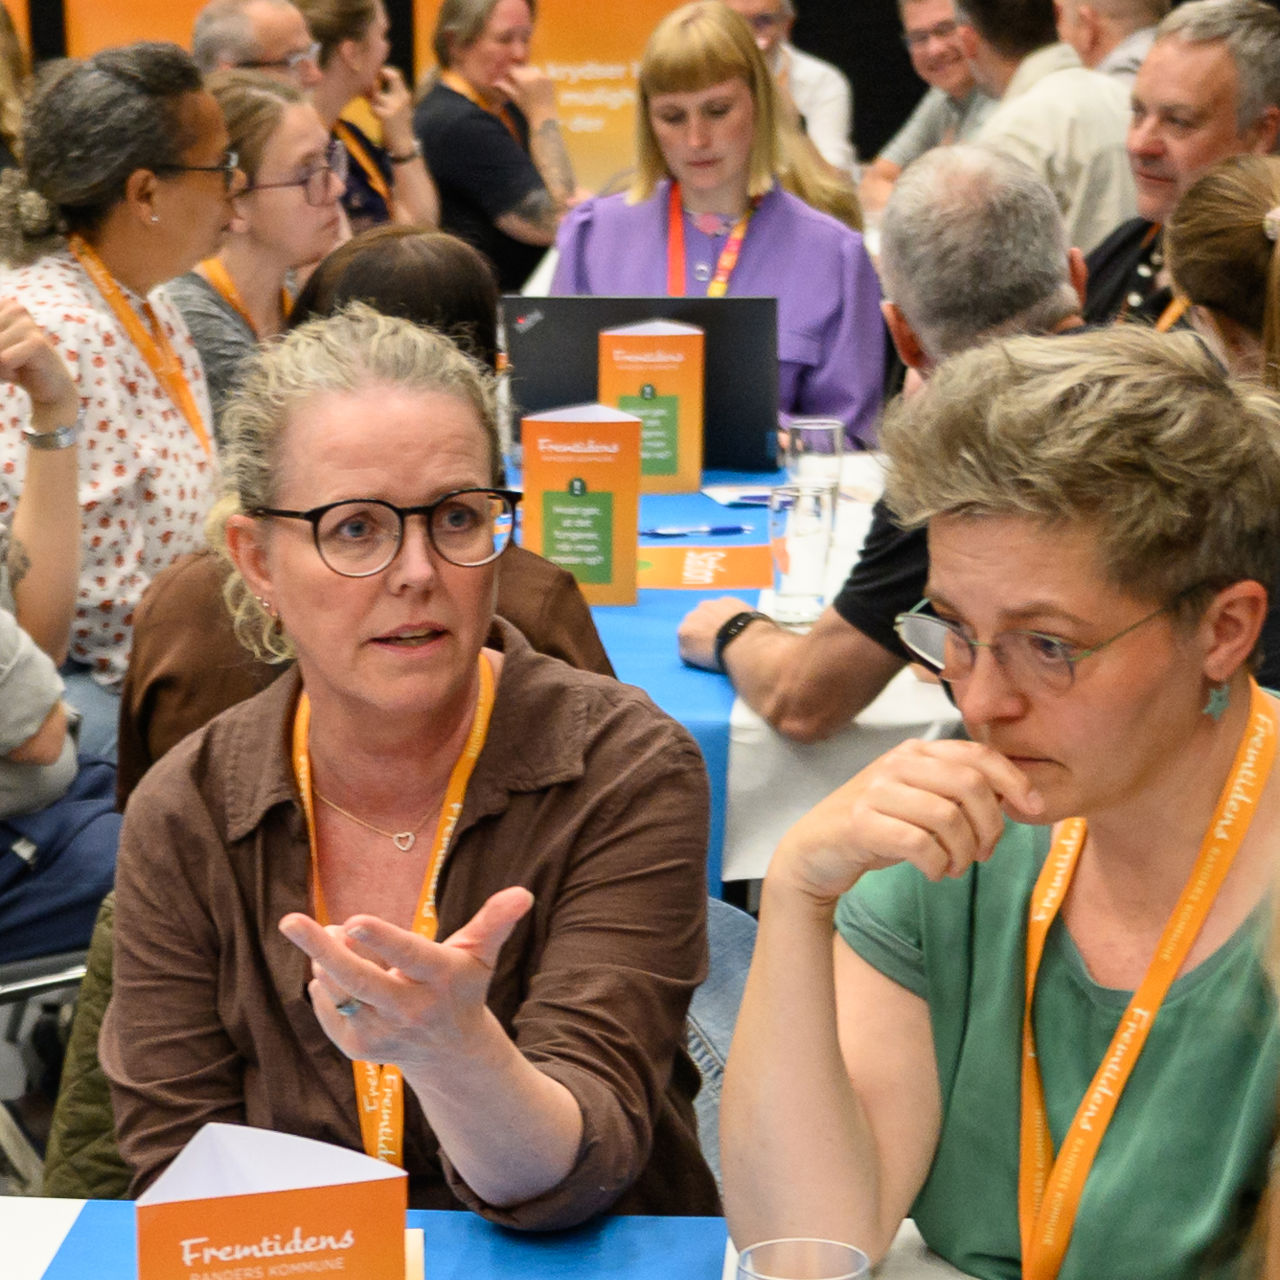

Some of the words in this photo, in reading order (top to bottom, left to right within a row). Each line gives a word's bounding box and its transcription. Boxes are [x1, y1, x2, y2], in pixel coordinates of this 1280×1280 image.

[1213, 712, 1276, 841] Fremtidens
[1079, 1006, 1151, 1132] Fremtidens
[179, 1226, 355, 1267] Fremtidens
[268, 1257, 345, 1277] KOMMUNE
